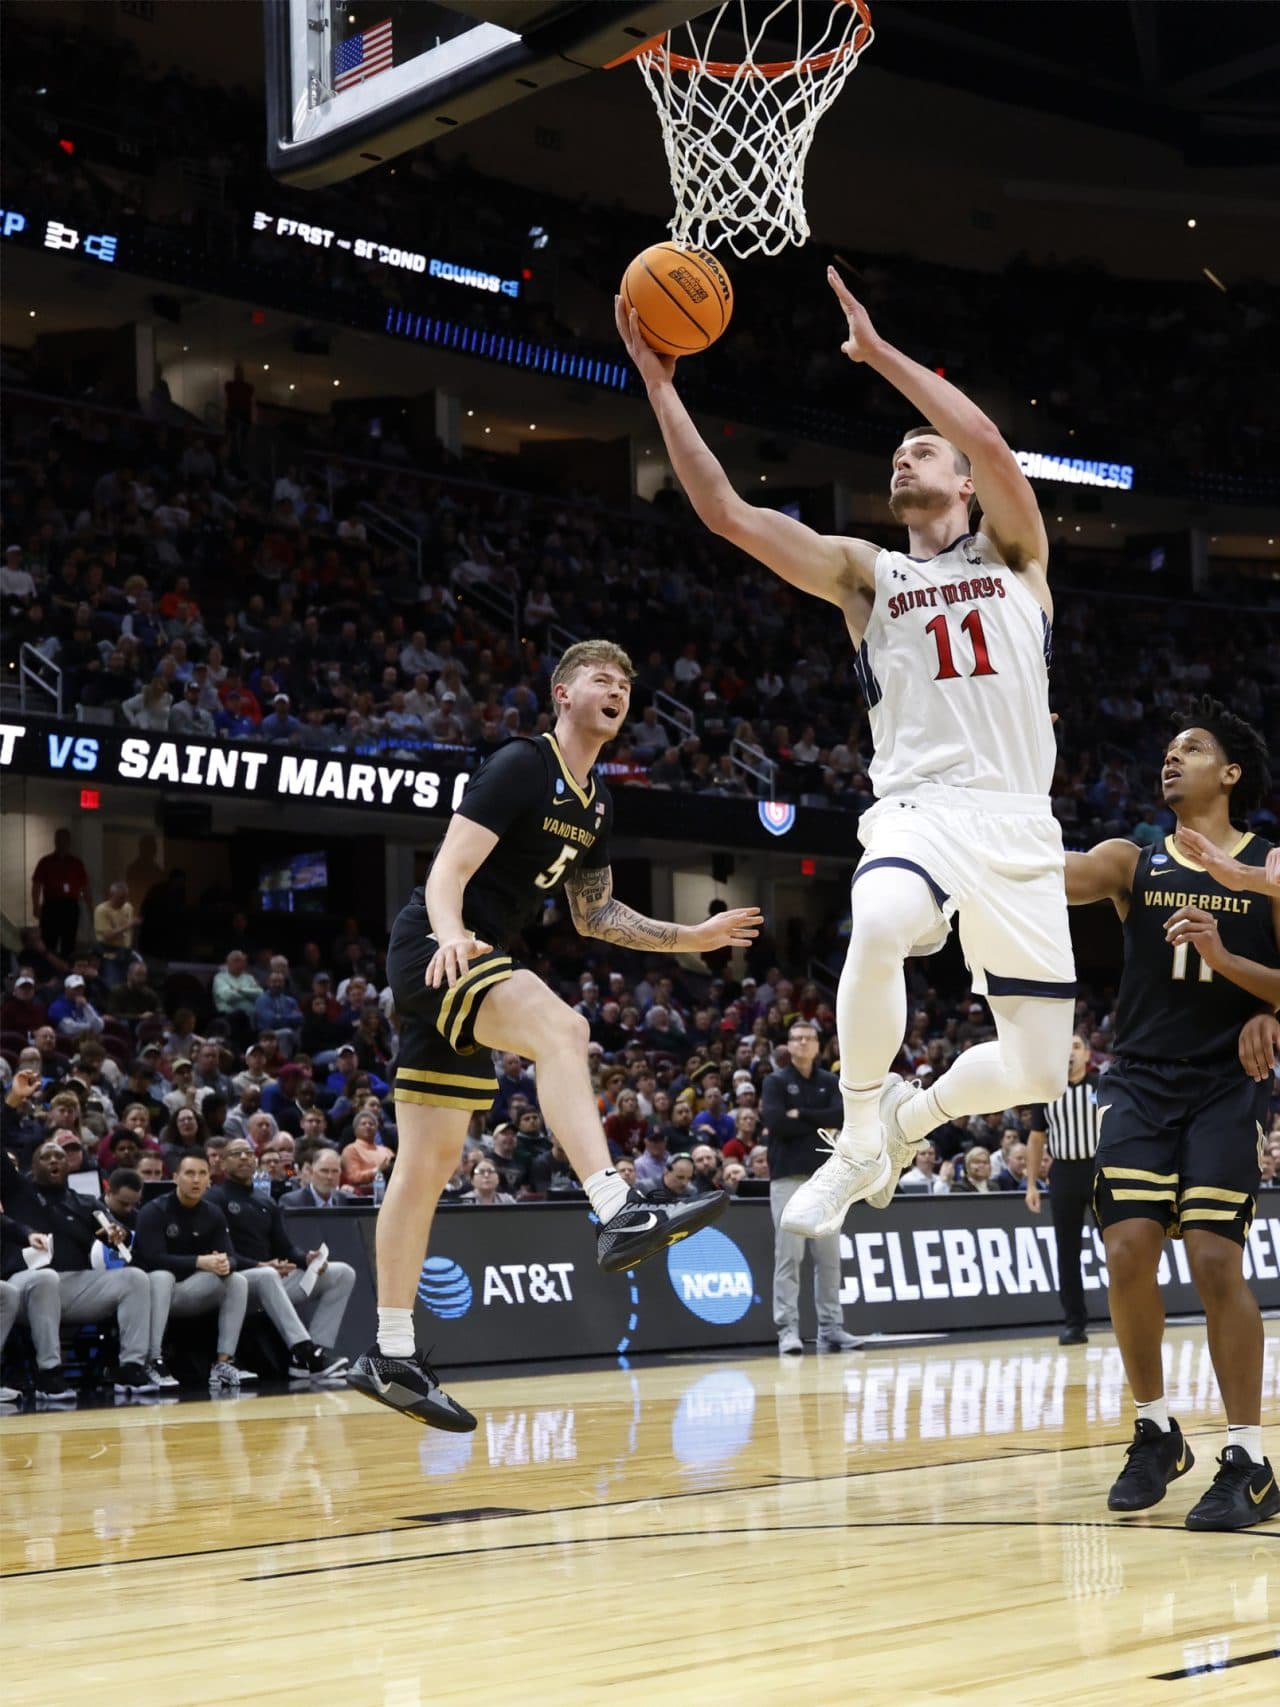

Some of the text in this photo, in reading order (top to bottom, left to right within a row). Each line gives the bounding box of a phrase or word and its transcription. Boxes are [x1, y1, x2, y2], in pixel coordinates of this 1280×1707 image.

[429, 259, 501, 293] ROUNDS
[888, 587, 938, 619] SAINT
[925, 609, 999, 681] 11
[47, 735, 99, 771] VS
[118, 738, 268, 789] SAINT
[278, 756, 440, 809] MARY'S
[534, 843, 579, 889] 5
[1144, 891, 1251, 914] VANDERBILT
[483, 1263, 574, 1305] AT&T
[682, 1272, 752, 1300] NCAA
